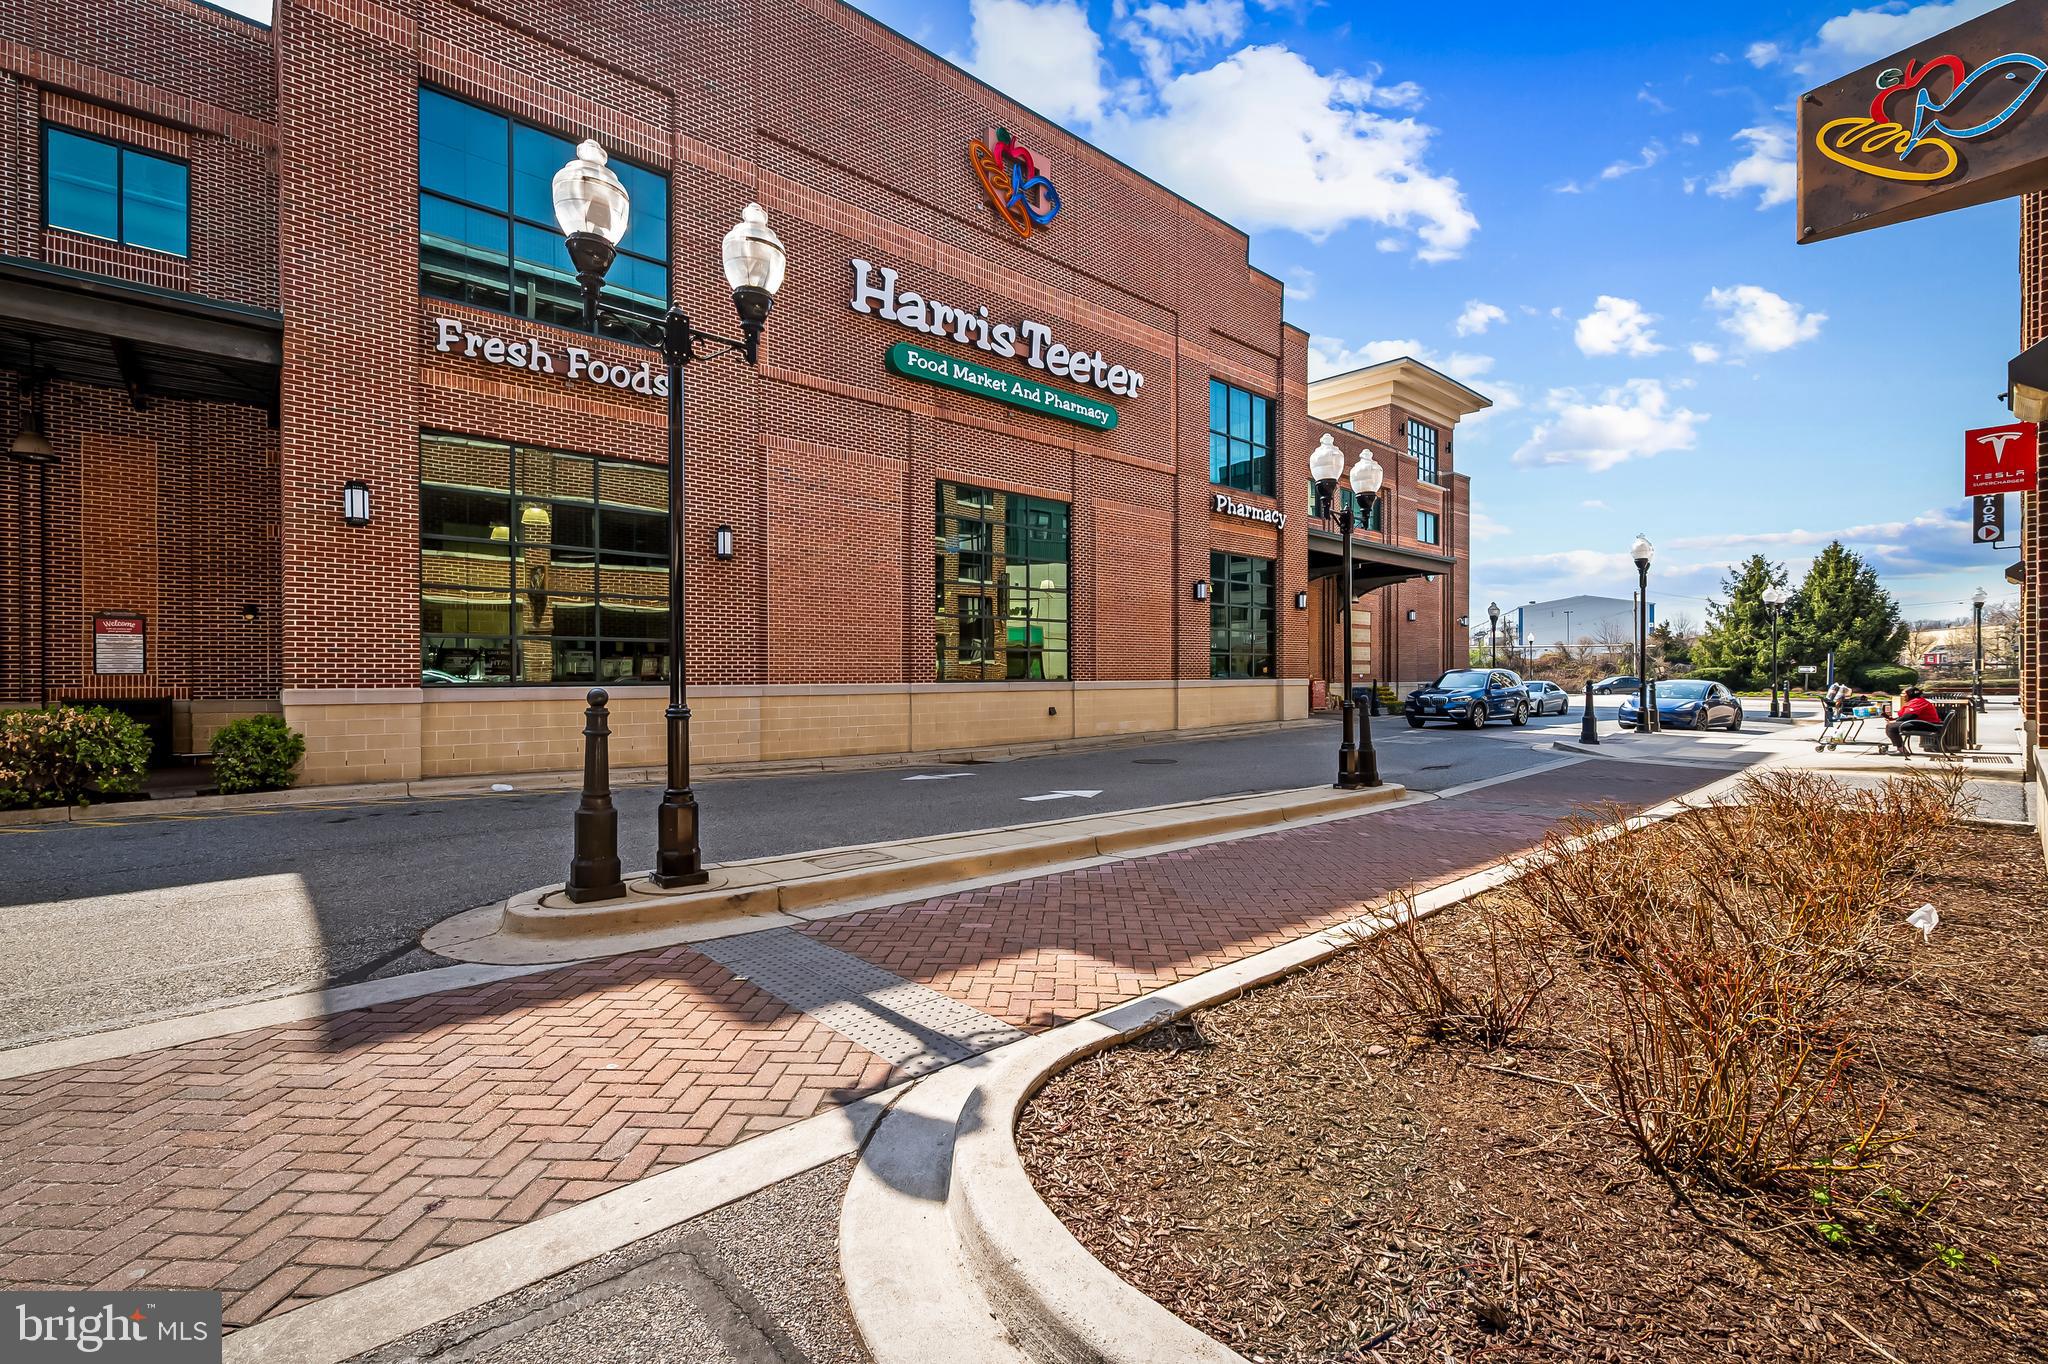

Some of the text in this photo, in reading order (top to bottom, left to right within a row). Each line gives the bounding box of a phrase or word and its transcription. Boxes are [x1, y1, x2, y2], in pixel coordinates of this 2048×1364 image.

[851, 259, 1144, 398] Harris Teeter
[436, 318, 669, 396] Fresh Foods
[907, 351, 1110, 425] Food Market And Pharmacy
[1973, 470, 2025, 480] TESLA
[1973, 478, 2025, 487] SUPERCHARGER
[1216, 494, 1287, 529] Pharmacy
[1983, 493, 1995, 523] TOR
[102, 619, 136, 628] Welcome
